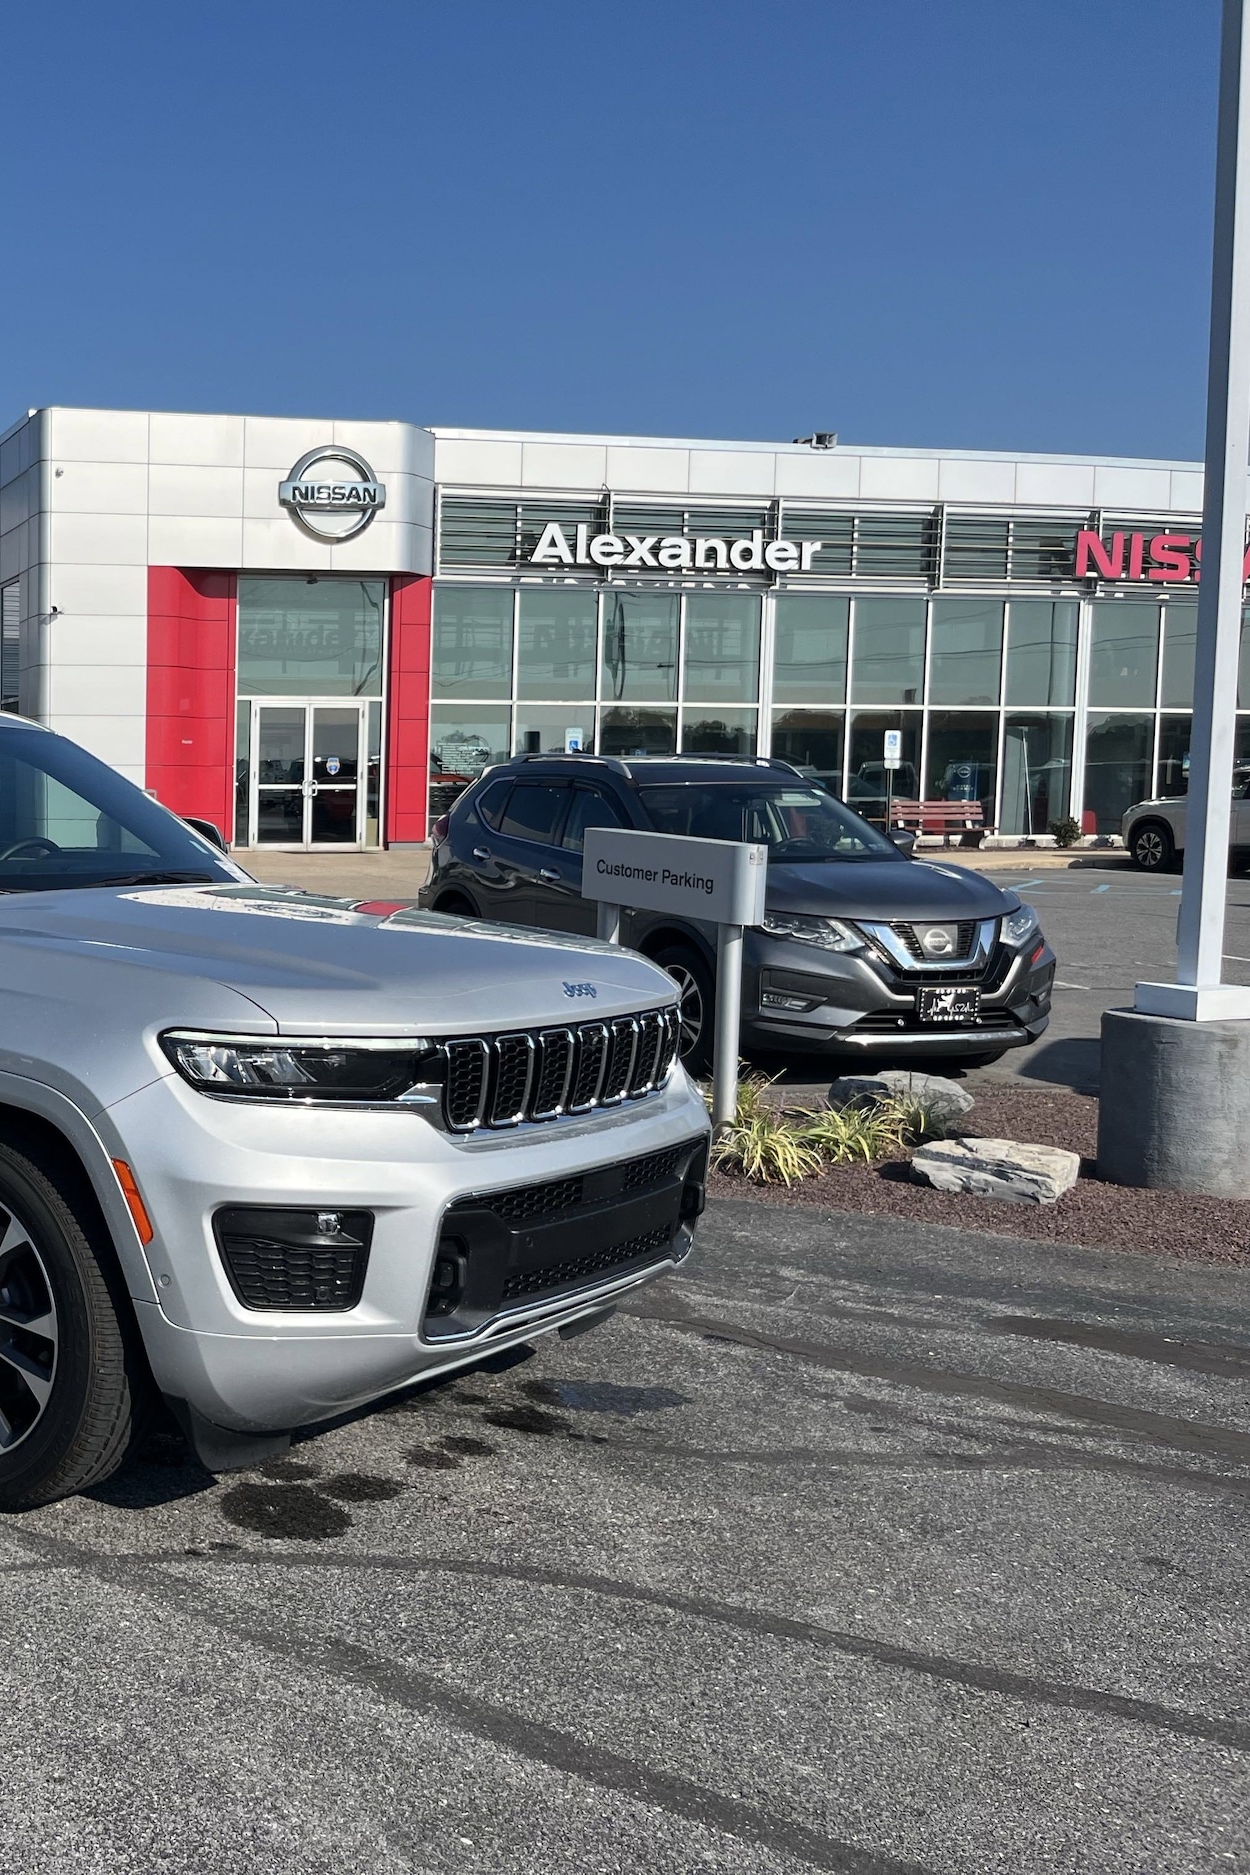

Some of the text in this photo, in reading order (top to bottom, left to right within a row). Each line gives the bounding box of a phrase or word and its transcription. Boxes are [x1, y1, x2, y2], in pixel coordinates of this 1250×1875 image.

[291, 484, 378, 504] NISSAN
[530, 522, 822, 571] Alexander
[1075, 530, 1250, 582] NIS
[596, 859, 714, 894] Customer Parking
[562, 981, 597, 999] Jeep
